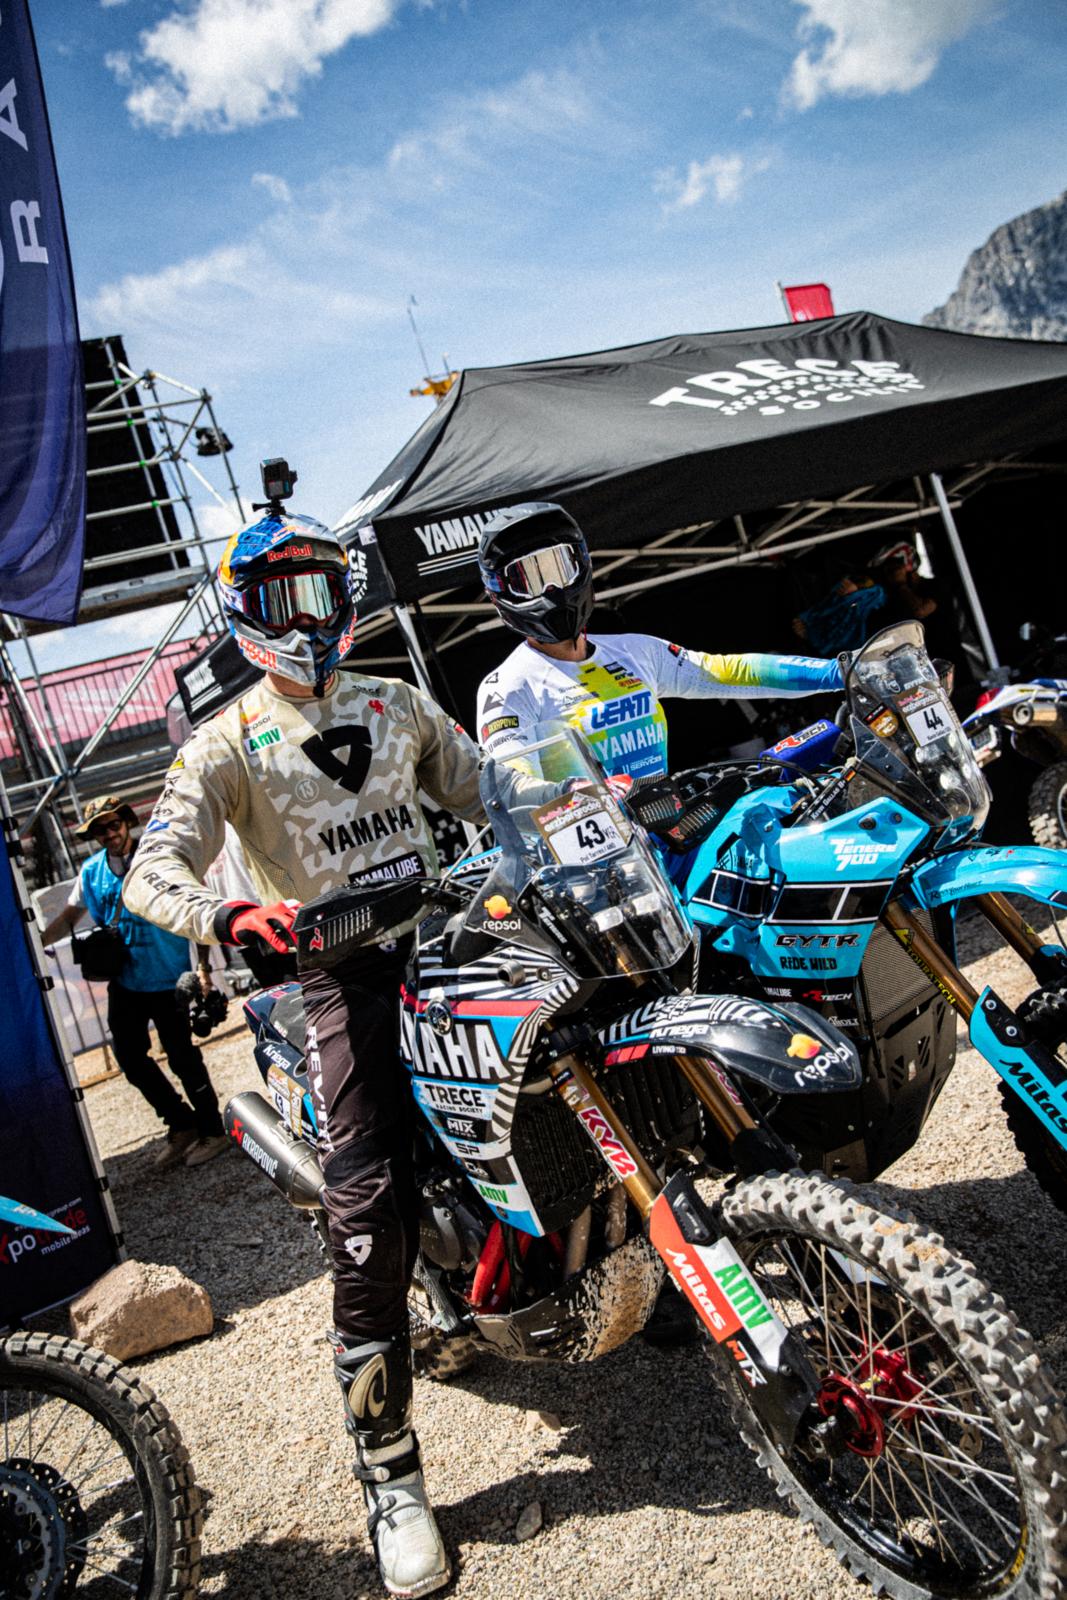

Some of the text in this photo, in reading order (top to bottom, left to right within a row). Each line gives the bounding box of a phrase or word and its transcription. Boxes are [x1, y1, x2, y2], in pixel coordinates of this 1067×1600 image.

[650, 359, 914, 408] TRECE
[414, 507, 504, 556] YAMA
[290, 544, 313, 558] Bull
[923, 707, 944, 730] 44
[596, 723, 664, 760] YAMAHA
[318, 804, 414, 856] YAMAHA
[576, 819, 606, 848] 43
[836, 853, 879, 872] 700
[483, 920, 521, 932] repsol
[776, 933, 859, 948] GYTR
[810, 956, 837, 971] WILD
[263, 1044, 292, 1070] Kriega
[794, 1042, 854, 1087] repsol
[425, 1084, 486, 1107] TRECE
[1000, 1058, 1067, 1135] Mitas
[447, 1117, 476, 1134] MTX
[578, 1106, 639, 1178] KYB
[666, 1248, 726, 1331] Mitas
[726, 1340, 768, 1388] MTX
